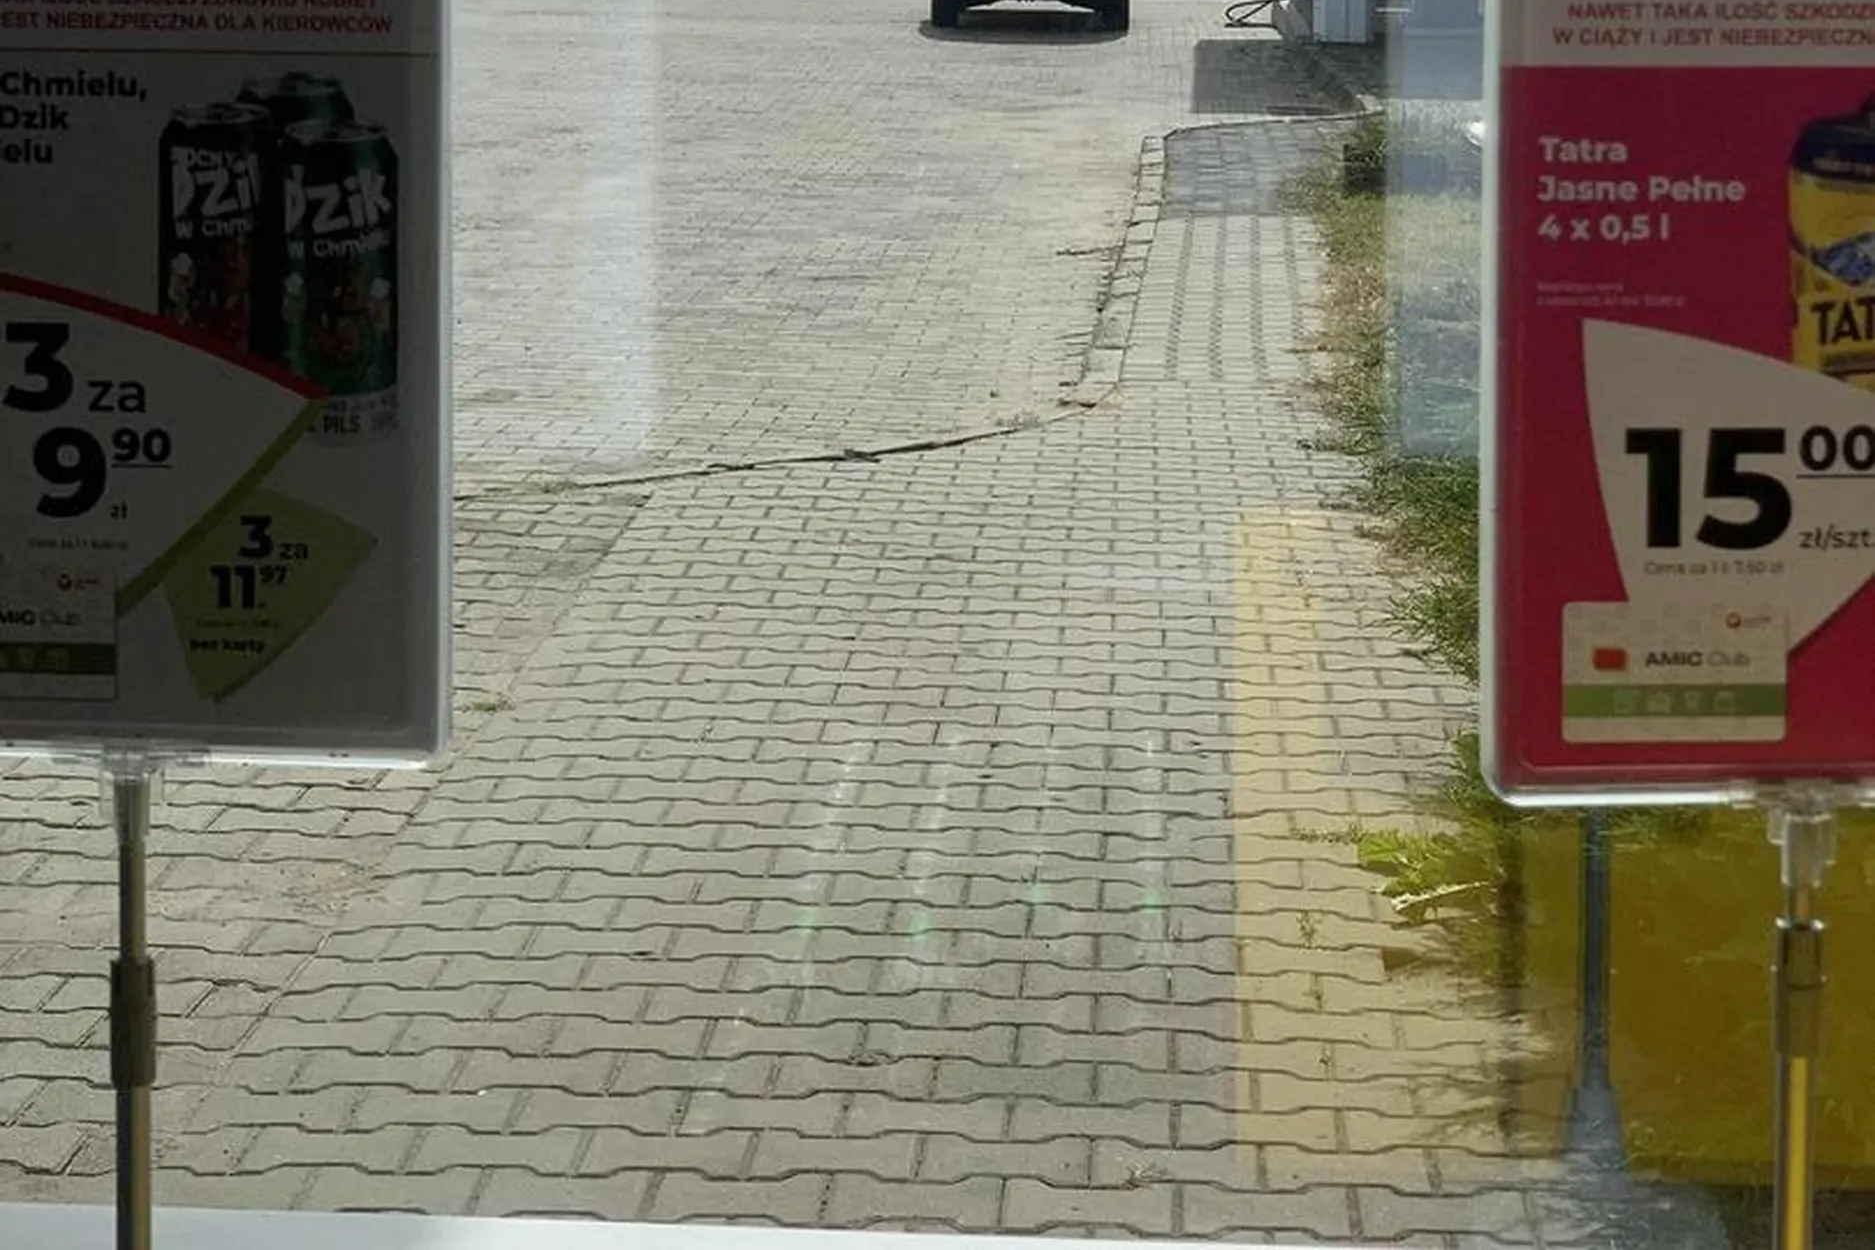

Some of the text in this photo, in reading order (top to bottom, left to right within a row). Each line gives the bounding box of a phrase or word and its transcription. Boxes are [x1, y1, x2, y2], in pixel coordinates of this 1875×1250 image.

[47, 12, 208, 30] NIEBEZPIECZNA
[216, 14, 256, 31] DLA
[264, 13, 392, 34] KIEROWCÓW
[1567, 2, 1645, 20] NAWET
[1652, 2, 1708, 20] TAKA
[1552, 28, 1573, 45] W
[1579, 25, 1643, 51] CIĄŻY
[1663, 28, 1714, 46] JEST
[0, 69, 147, 102] Chmielu,
[0, 103, 69, 130] Dzik
[1537, 135, 1629, 163] Tatra
[1537, 174, 1747, 202] Jasne Pełne
[1537, 212, 1670, 246] 4 x 0,5 l
[1810, 296, 1875, 346] TAT
[4, 323, 146, 414] 3 za
[324, 413, 361, 435] PILS
[33, 427, 172, 518] 9 90
[1626, 425, 1875, 550] 15 00
[238, 515, 309, 560] 3 za
[209, 565, 287, 609] 11 97
[1644, 651, 1704, 667] AMIC
